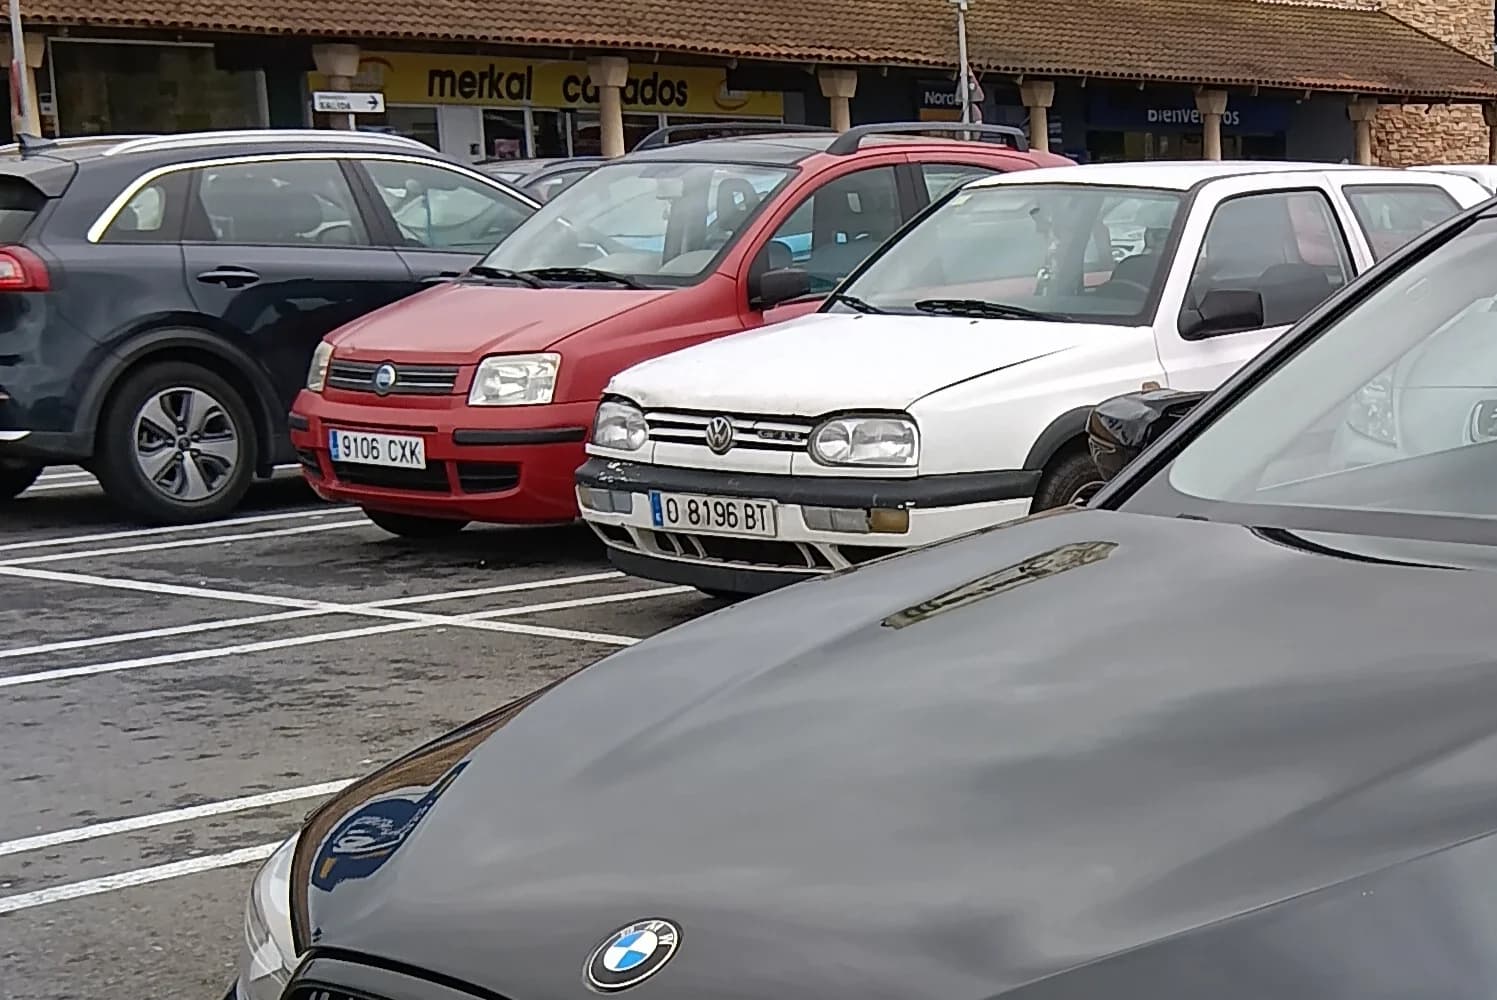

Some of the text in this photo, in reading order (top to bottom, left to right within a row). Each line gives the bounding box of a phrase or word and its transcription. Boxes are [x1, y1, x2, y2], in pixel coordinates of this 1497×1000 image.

[428, 64, 689, 107] merkal caados
[342, 435, 421, 465] 9106 CXK
[687, 499, 738, 528] 8196
[744, 503, 767, 531] BT
